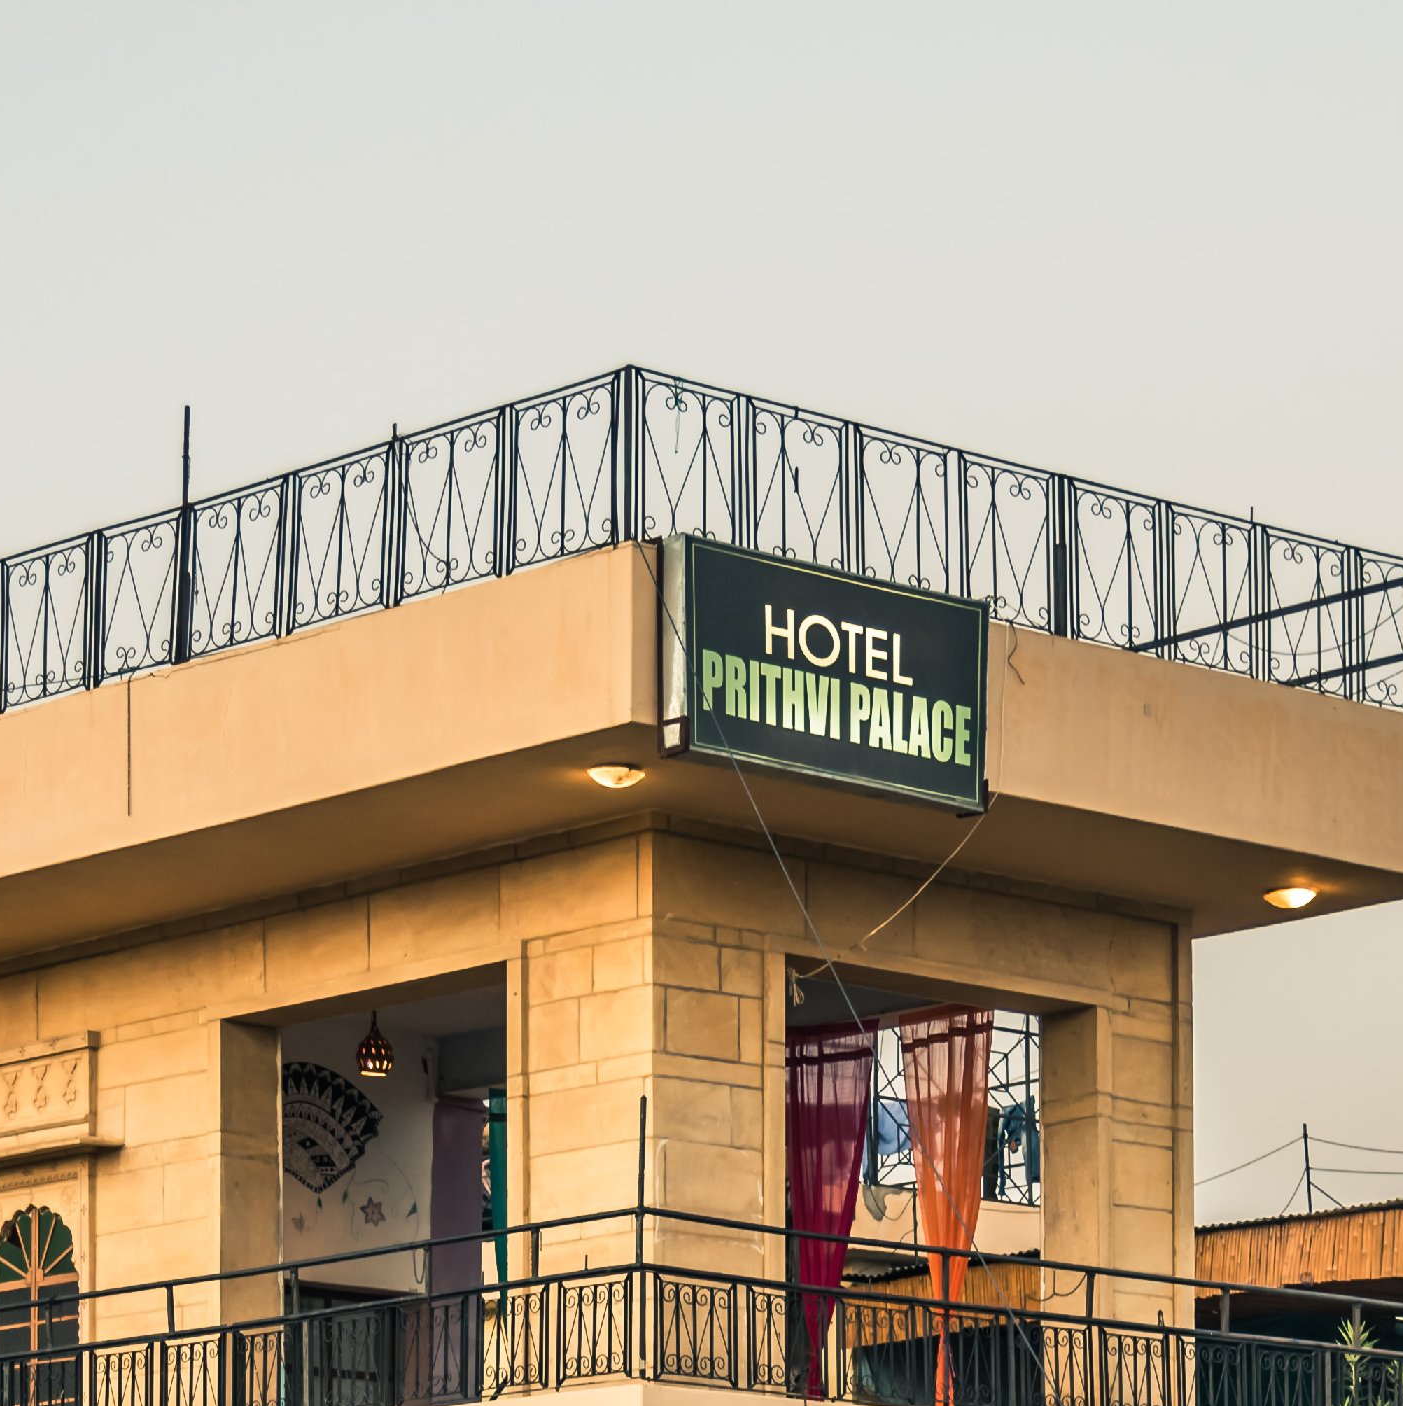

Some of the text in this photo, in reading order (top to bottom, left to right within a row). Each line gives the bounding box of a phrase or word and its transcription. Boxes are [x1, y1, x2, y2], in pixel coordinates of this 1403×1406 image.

[764, 604, 914, 686] HOTEL
[702, 648, 972, 767] PRITHVI PALACE
